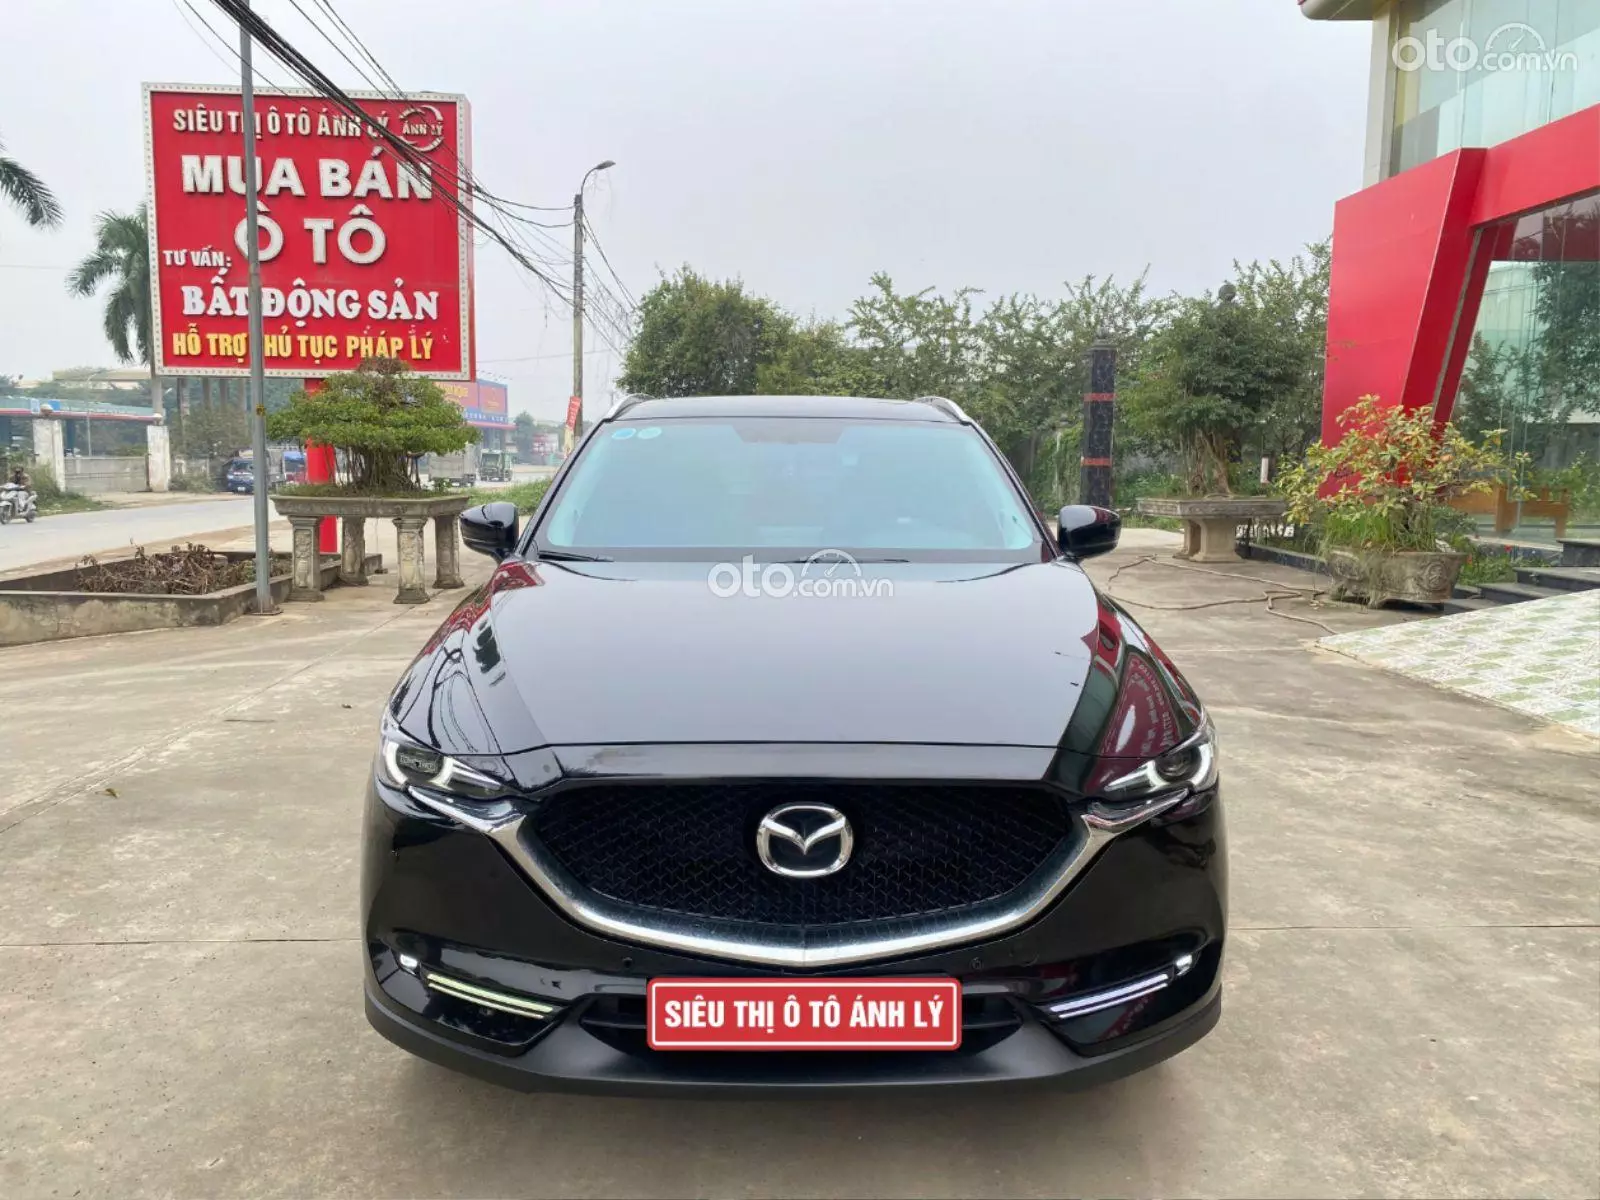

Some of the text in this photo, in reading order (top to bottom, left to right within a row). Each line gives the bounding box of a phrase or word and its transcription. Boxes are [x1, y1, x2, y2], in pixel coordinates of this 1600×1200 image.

[173, 103, 223, 132] SIÊU
[227, 111, 262, 139] TỊ
[267, 105, 280, 134] Ô
[284, 106, 311, 135] TÔ
[317, 108, 361, 137] ÁNH
[182, 146, 432, 199] MUA BÁN
[234, 200, 387, 264] Ô TÔ
[163, 245, 232, 267] TƯ VẤN:
[181, 267, 439, 328] BẤT ĐỘNG SẢN
[172, 323, 433, 364] HỖ TRỢ HỦ TỤC PHÁP LÝ
[664, 994, 944, 1033] SIÊU THỊ Ô TÔ ÁNH LÝ
